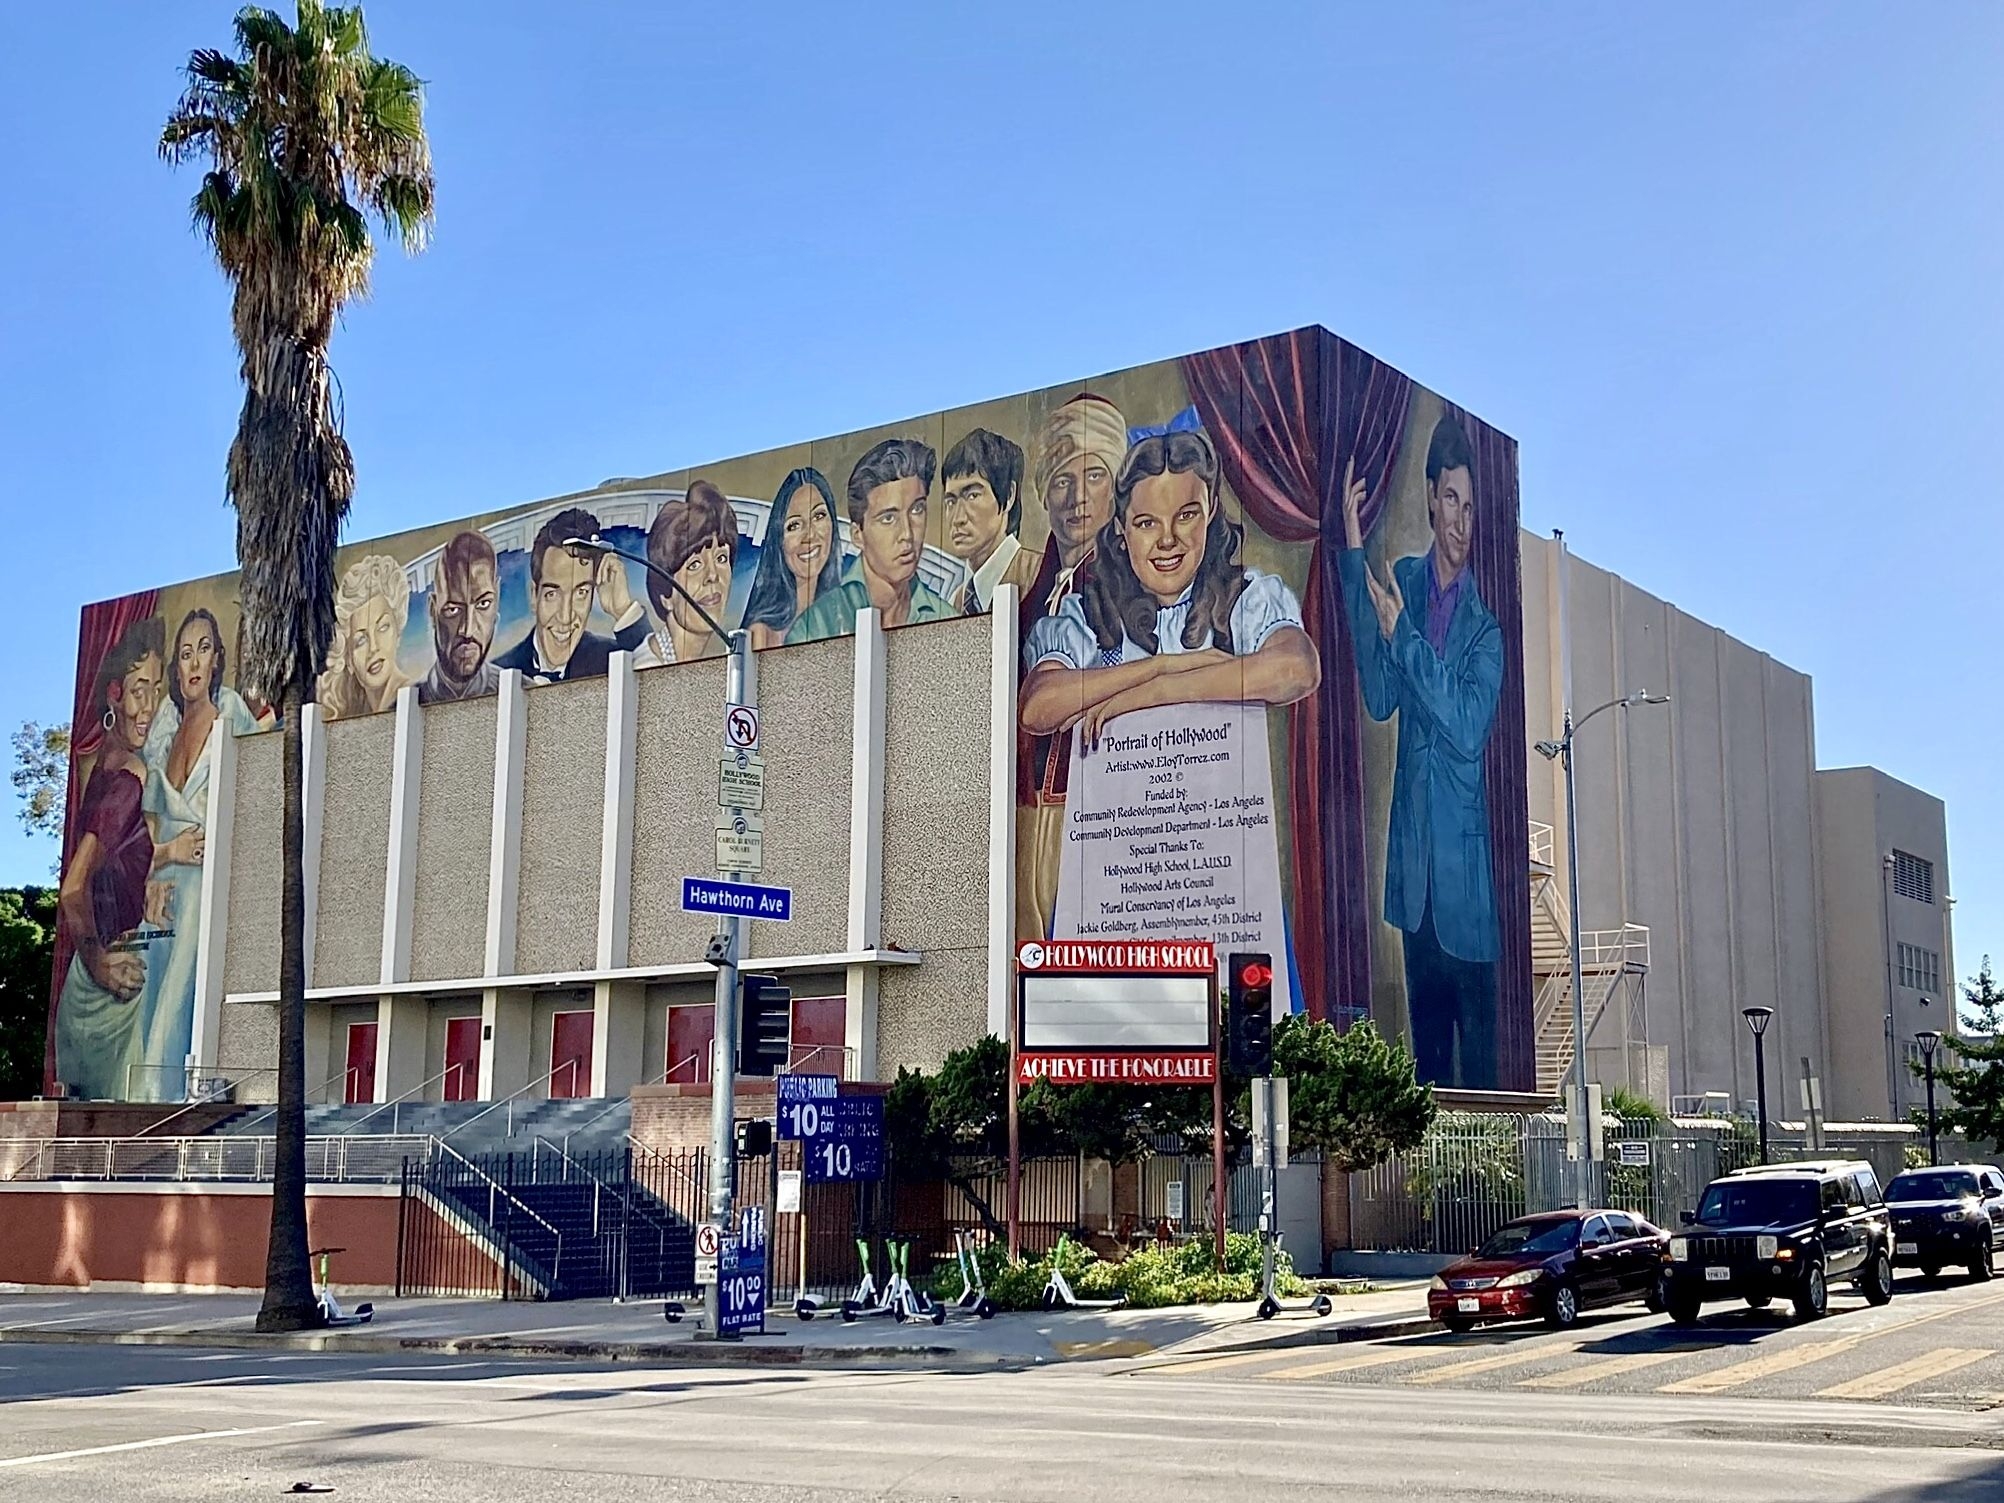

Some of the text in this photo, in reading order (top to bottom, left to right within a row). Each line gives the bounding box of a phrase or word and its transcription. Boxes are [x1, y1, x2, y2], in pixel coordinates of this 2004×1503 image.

[1102, 723, 1231, 752] "Portrait of Hollywood"
[722, 776, 762, 787] HIGH SCHOOL
[724, 769, 760, 781] HOLLYWOOD
[1149, 772, 1173, 784] 2002
[1145, 788, 1188, 801] Funded by:
[1073, 809, 1116, 822] Community
[1117, 803, 1176, 818] Redevelopment
[1177, 801, 1207, 815] Agency
[1214, 798, 1230, 809] Los
[1231, 795, 1265, 809] Angeles
[1069, 828, 1112, 841] Community
[1113, 823, 1163, 838] Development
[1165, 818, 1211, 835] Department
[1218, 817, 1234, 828] Los
[1235, 813, 1269, 828] Angeles
[1129, 839, 1204, 858] Special Thanks To:
[1104, 863, 1143, 878] Hollywood
[1144, 861, 1163, 876] High
[1164, 859, 1191, 872] School,
[1120, 876, 1214, 894] Hollywood Arts Council
[690, 886, 783, 912] Hawthorn Ave
[1100, 894, 1236, 914] Mural Conservancy of Los Angeles
[1076, 922, 1099, 935] Jackie
[1100, 920, 1138, 933] Goldberg,
[1211, 913, 1230, 925] 45th
[1232, 912, 1261, 924] District
[1212, 932, 1230, 944] 13th
[1231, 931, 1261, 943] District
[1045, 945, 1213, 968] HOLLYWOOD HIGH SCHOOL
[1020, 1058, 1213, 1079] ACHIEVE THE HONORABLE
[808, 1077, 838, 1099] PARKING
[820, 1105, 835, 1117] ALL
[820, 1121, 835, 1133] DAY
[722, 1312, 762, 1326] FLAT RATE
